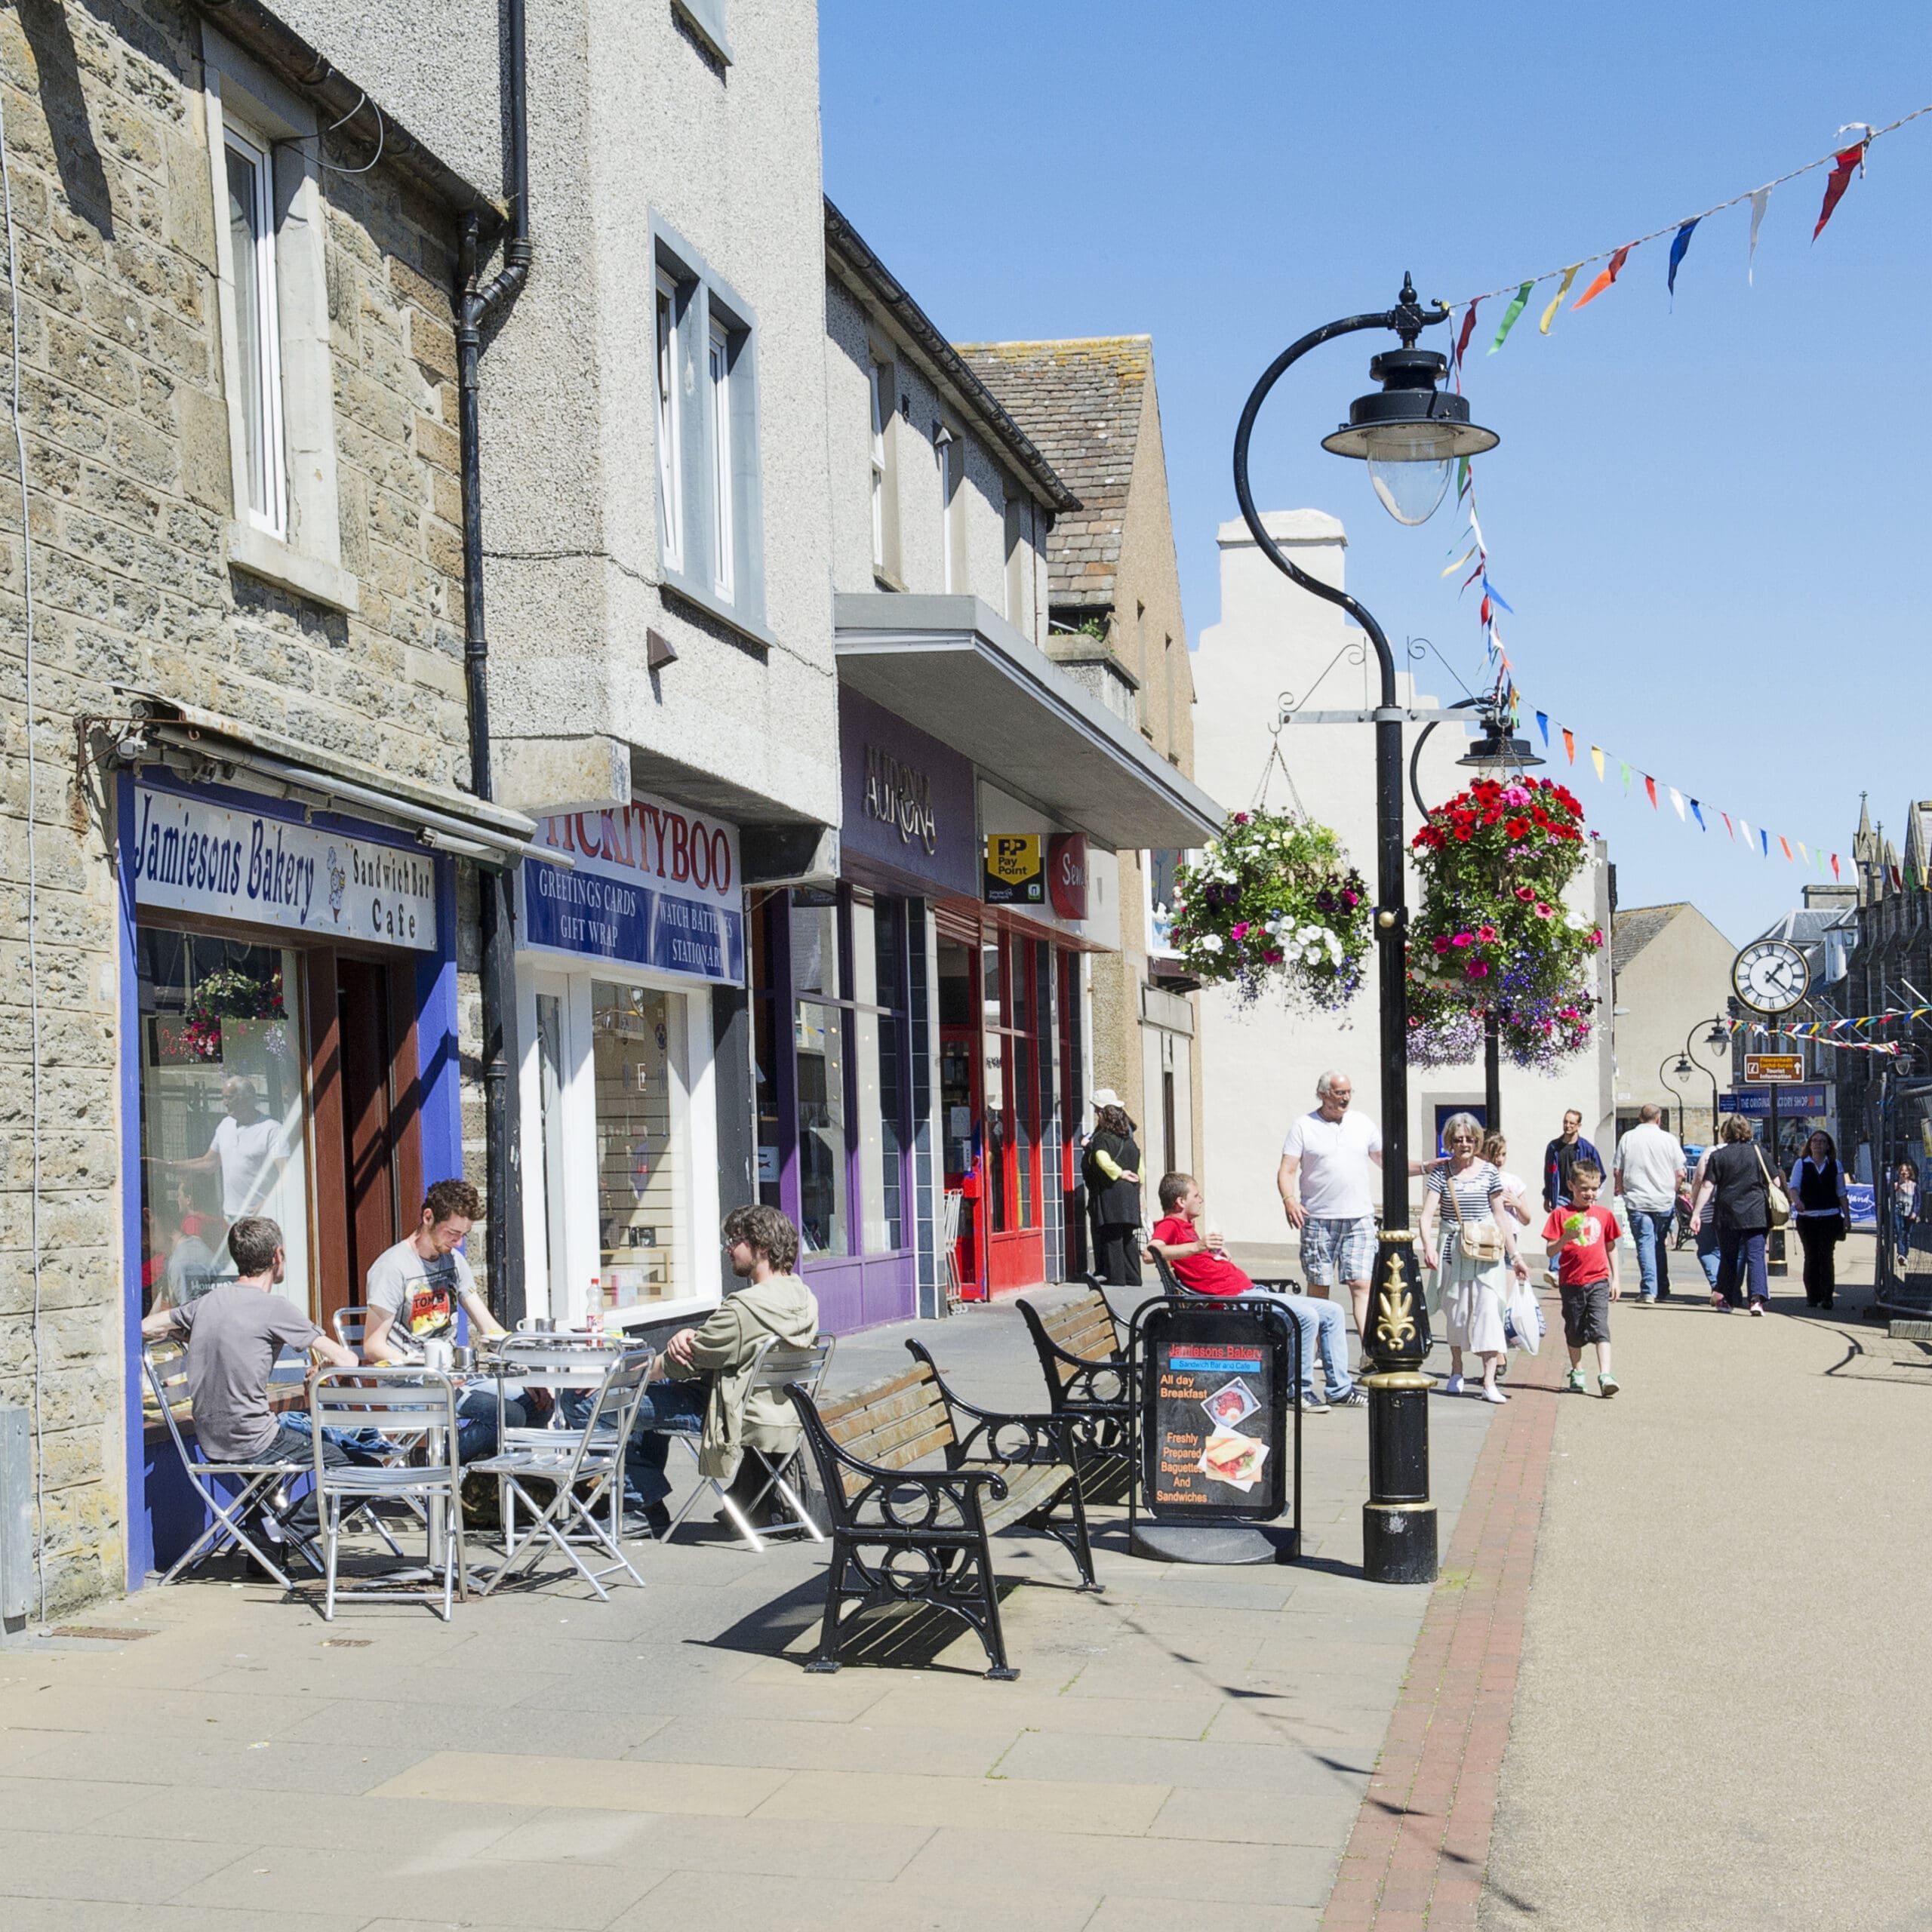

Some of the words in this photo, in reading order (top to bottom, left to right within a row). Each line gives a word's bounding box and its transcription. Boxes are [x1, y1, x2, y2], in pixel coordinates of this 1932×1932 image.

[135, 793, 242, 896] Jamiesons
[247, 819, 314, 925] Bakery
[998, 857, 1017, 868] Pay
[353, 848, 409, 894] Sandwich
[411, 862, 429, 899] Bar
[998, 866, 1027, 875] Point
[539, 869, 601, 908] GREETINGS
[605, 884, 636, 917] CARDS
[372, 897, 416, 939] Cafe
[659, 900, 689, 928] WATCH
[691, 908, 734, 938] BATTES
[561, 915, 586, 941] GIFT
[589, 920, 618, 947] WRAP
[1740, 1098, 1749, 1108] THE
[1750, 1097, 1770, 1108] ORIGINA
[1794, 1095, 1808, 1106] SHOP
[1168, 1343, 1223, 1357] Jamiesons
[1226, 1346, 1263, 1359] Bakery
[1179, 1360, 1209, 1368] Sandwich
[1235, 1361, 1251, 1370] Cafe
[1160, 1374, 1174, 1385] All
[1176, 1375, 1195, 1388] day
[1160, 1388, 1208, 1398] Breakfast
[1166, 1432, 1198, 1446] Freshly
[1163, 1447, 1202, 1460] Prepared
[1161, 1461, 1204, 1475] Baguettes
[1173, 1476, 1191, 1487] And
[1156, 1490, 1208, 1503] Sandwiches
